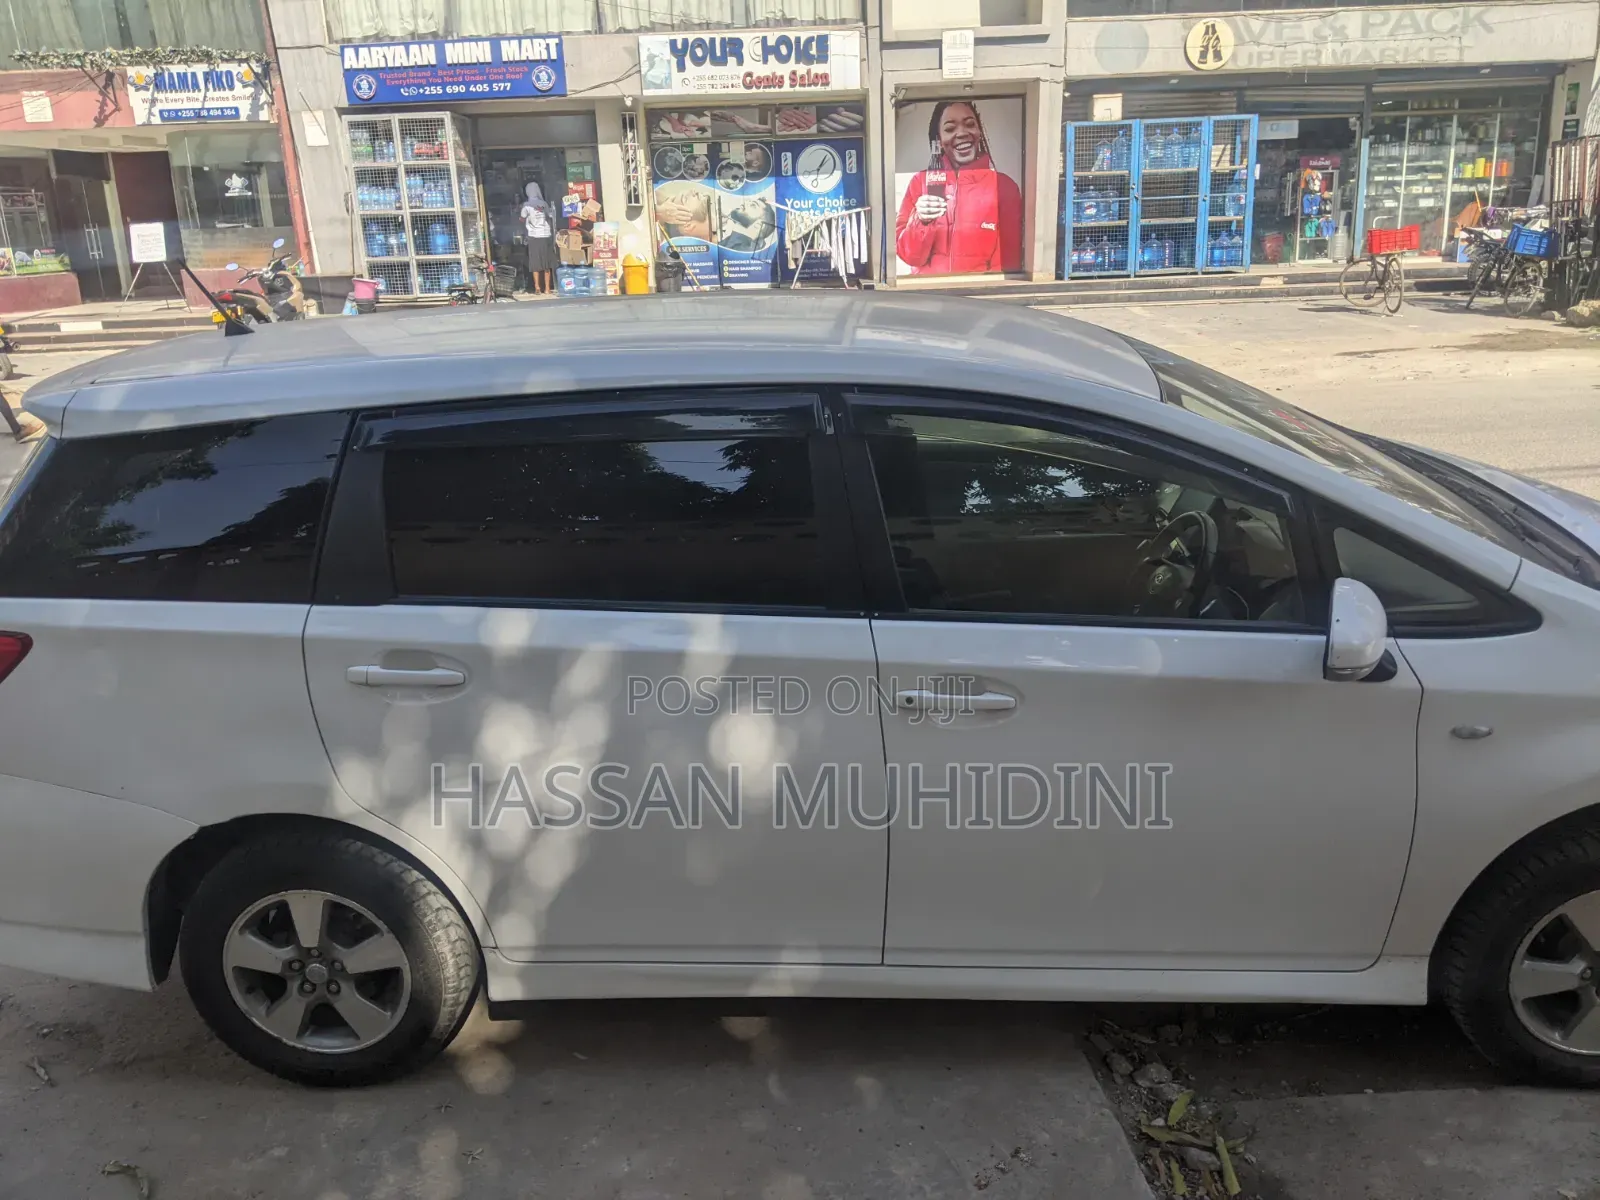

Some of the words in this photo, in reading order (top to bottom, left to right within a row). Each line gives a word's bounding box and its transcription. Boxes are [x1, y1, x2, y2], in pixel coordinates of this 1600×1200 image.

[1360, 6, 1495, 37] PACK
[344, 44, 437, 69] AARYAAN
[445, 41, 492, 64] MINI
[501, 38, 559, 62] MART
[669, 37, 744, 73] YOUR
[749, 34, 830, 66] CHOICE
[1231, 45, 1473, 68] UPERMARKET
[379, 71, 407, 80] Trusted
[409, 70, 431, 78] Brand
[486, 66, 506, 74] Fresh
[508, 65, 529, 73] Stock
[386, 76, 427, 86] Everything
[444, 75, 463, 83] Need
[465, 74, 487, 82] Under
[506, 72, 523, 80] Roof
[742, 71, 785, 90] Gents
[789, 68, 831, 88] Salon
[153, 71, 200, 92] MAMA
[419, 85, 443, 95] +255
[446, 84, 466, 94] 690
[469, 83, 489, 92] 405
[493, 82, 512, 91] 577
[165, 96, 185, 106] Every
[209, 108, 222, 116] 494
[223, 107, 236, 116] 364
[785, 198, 814, 210] Your
[817, 196, 857, 208] Choice
[682, 245, 707, 253] SERVICES
